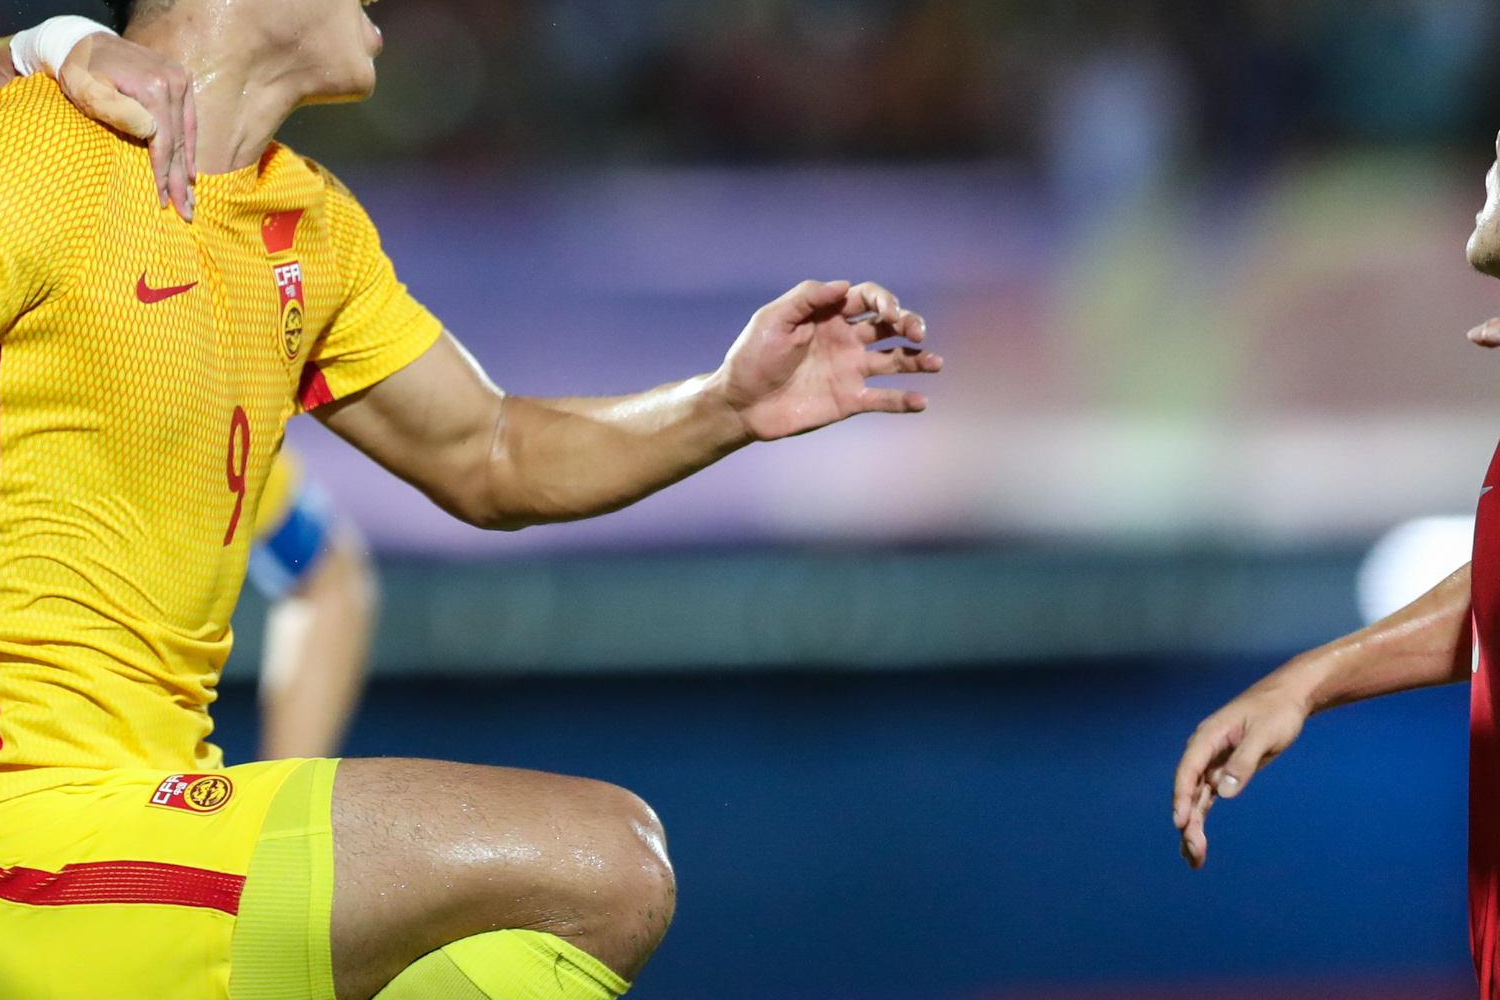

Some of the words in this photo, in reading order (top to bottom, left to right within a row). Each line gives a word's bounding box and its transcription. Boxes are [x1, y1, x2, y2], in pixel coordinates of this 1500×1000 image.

[274, 263, 301, 286] CFA
[223, 405, 250, 547] 9
[152, 775, 184, 804] CFA
